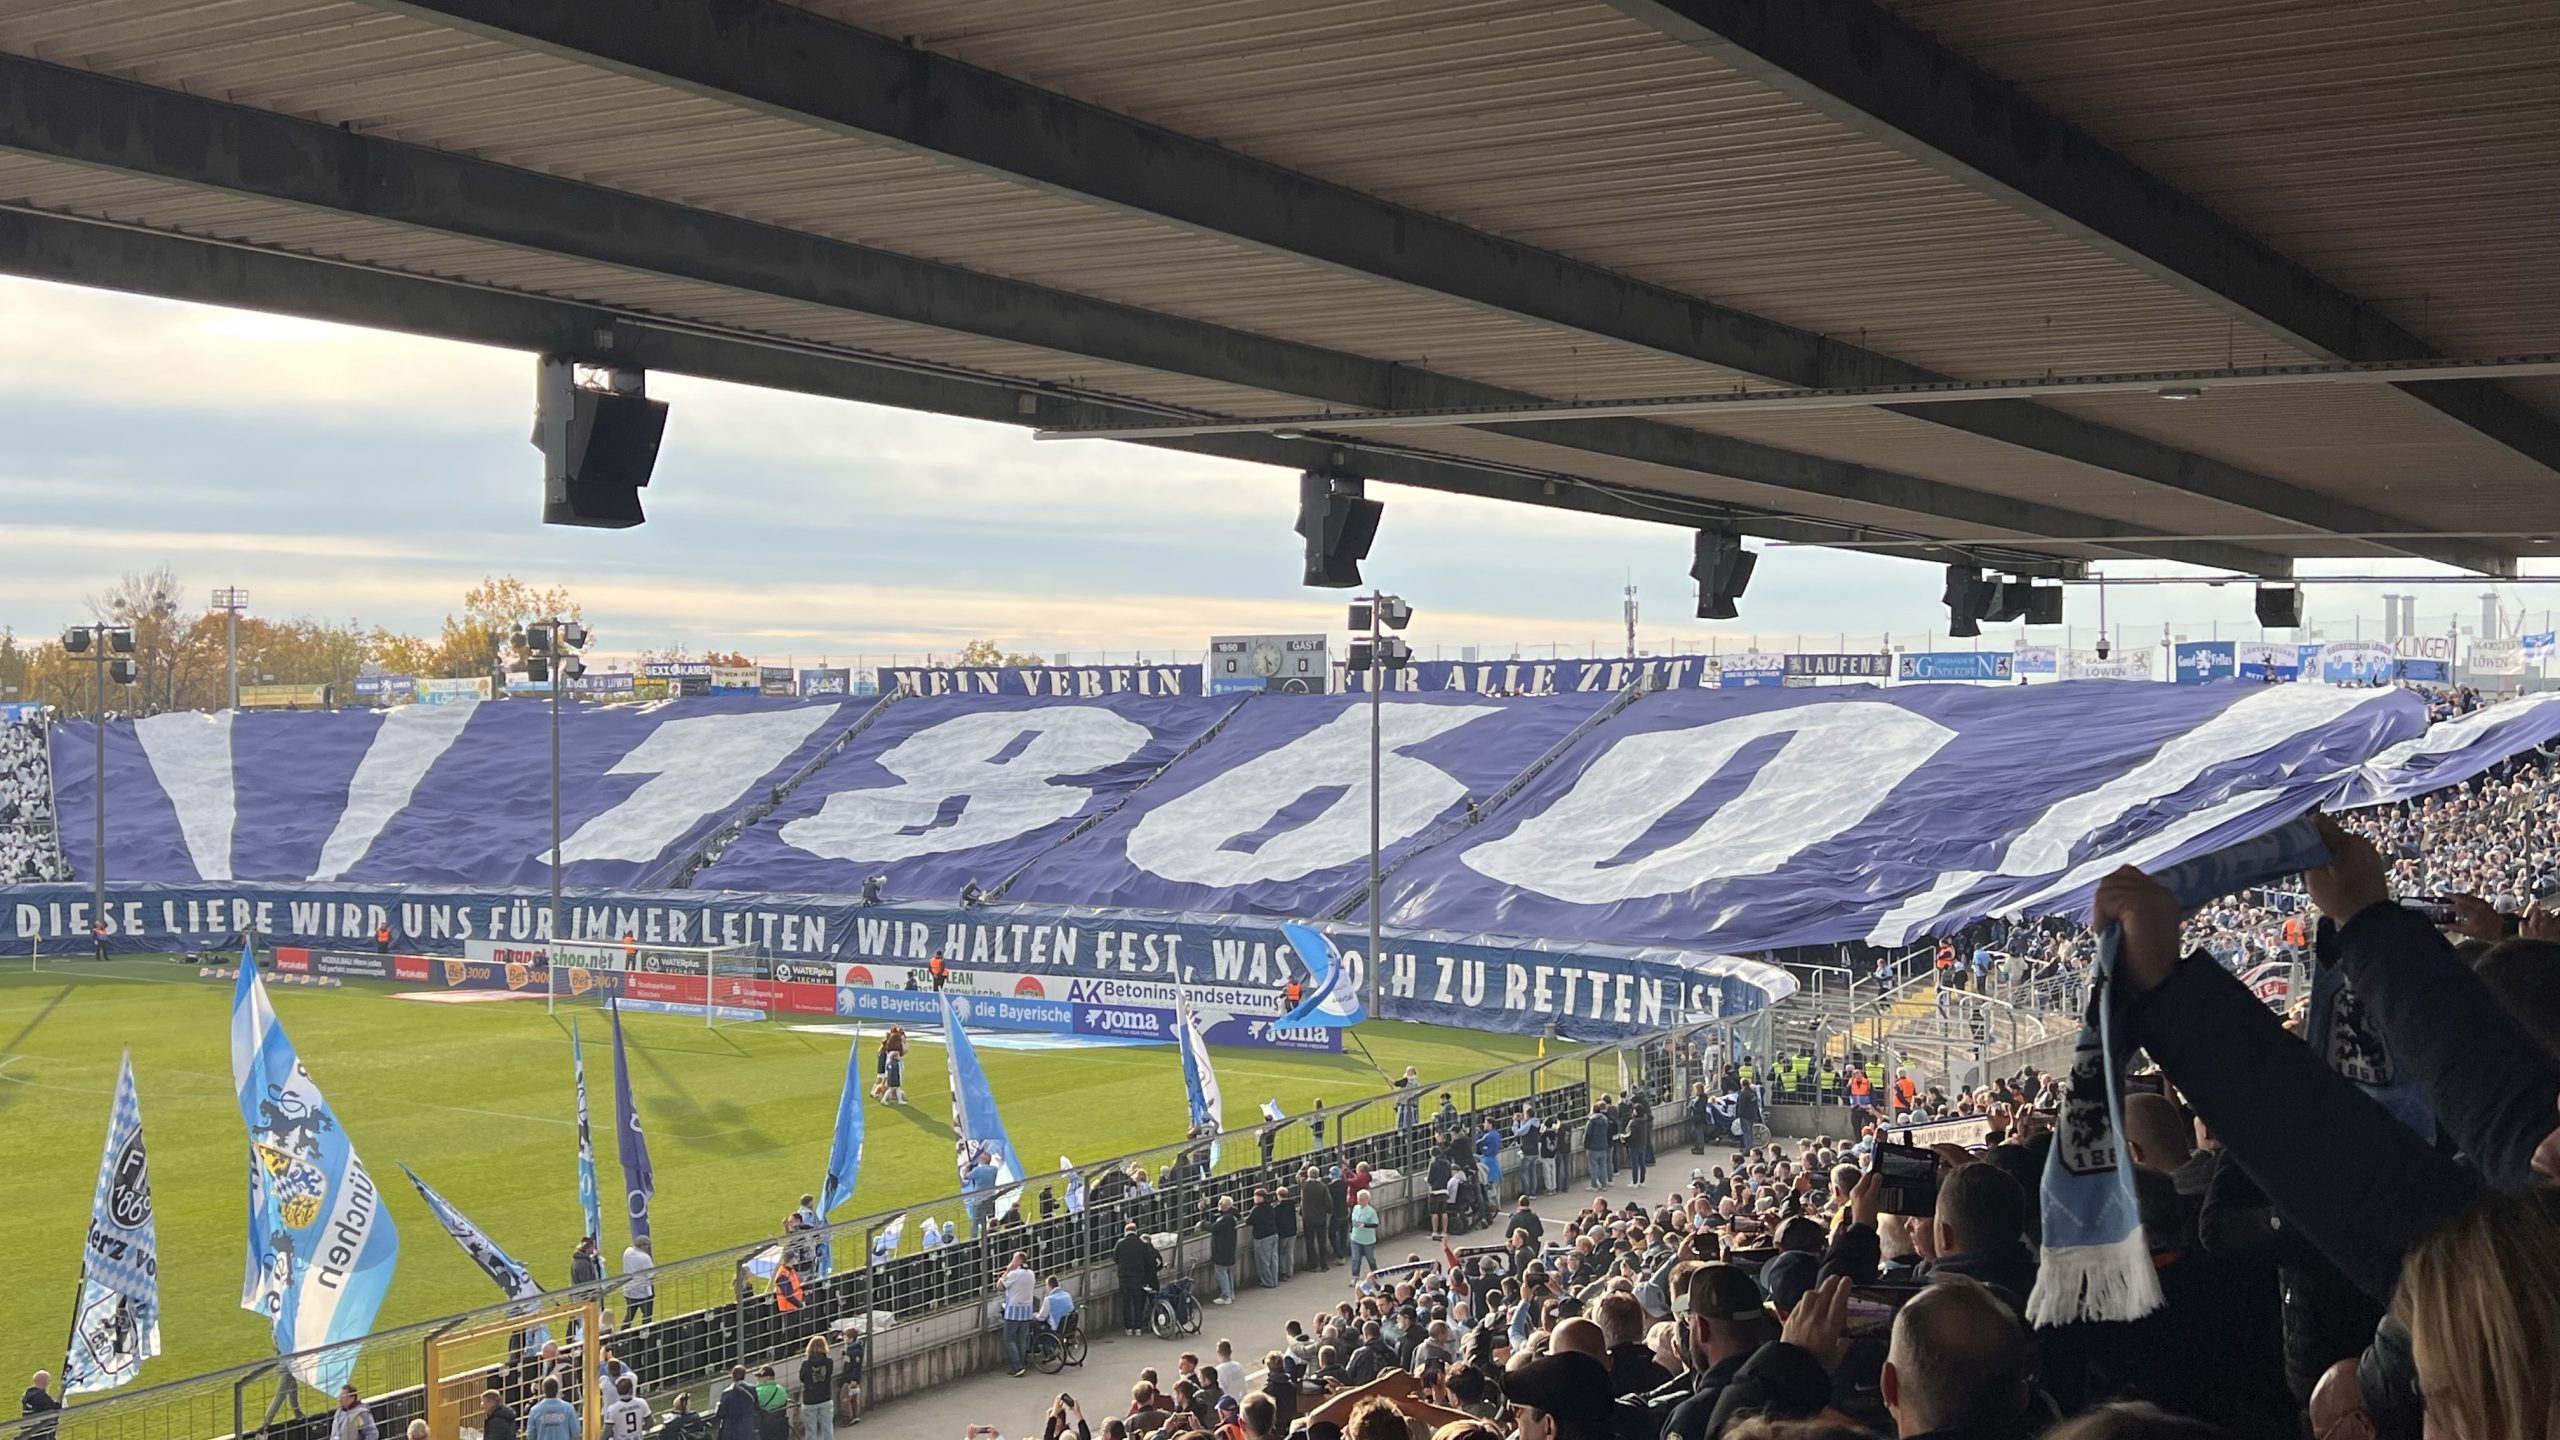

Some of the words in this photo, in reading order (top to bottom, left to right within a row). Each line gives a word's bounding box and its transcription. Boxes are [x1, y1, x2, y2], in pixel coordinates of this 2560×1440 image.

[1291, 640, 1319, 651] GAST
[2394, 636, 2453, 659] KLINGEN
[680, 664, 712, 676] KANER
[1228, 661, 1235, 672] 0
[1299, 661, 1306, 672] 0
[1804, 656, 1872, 674] LAUFEN
[894, 669, 999, 697] MEIN
[1019, 668, 1182, 698] VEREIN
[1444, 663, 1558, 697] ALLE
[1576, 660, 1692, 693] ZEIT
[16, 901, 145, 938] DIESE
[162, 898, 274, 935] LIEBE
[289, 900, 387, 939] WIRD
[401, 902, 473, 941] UNS
[488, 898, 553, 941] FÜR
[570, 905, 687, 944] IMMER
[856, 917, 930, 959] WIR
[943, 923, 1078, 966] HALTEN
[1212, 939, 1293, 987] WAS
[1433, 956, 1486, 1008] ZU
[1504, 962, 1664, 1027] RETTEN
[1678, 981, 1724, 1024] IST
[552, 947, 614, 970] shop.net
[791, 964, 834, 978] WATERplus
[911, 968, 974, 986] POLLEAN
[1066, 979, 1104, 1004] AK
[858, 995, 877, 1009] die
[881, 997, 943, 1014] Bayerisch
[974, 1001, 996, 1017] die
[999, 1003, 1072, 1023] Bayerische
[626, 1411, 637, 1434] 9
